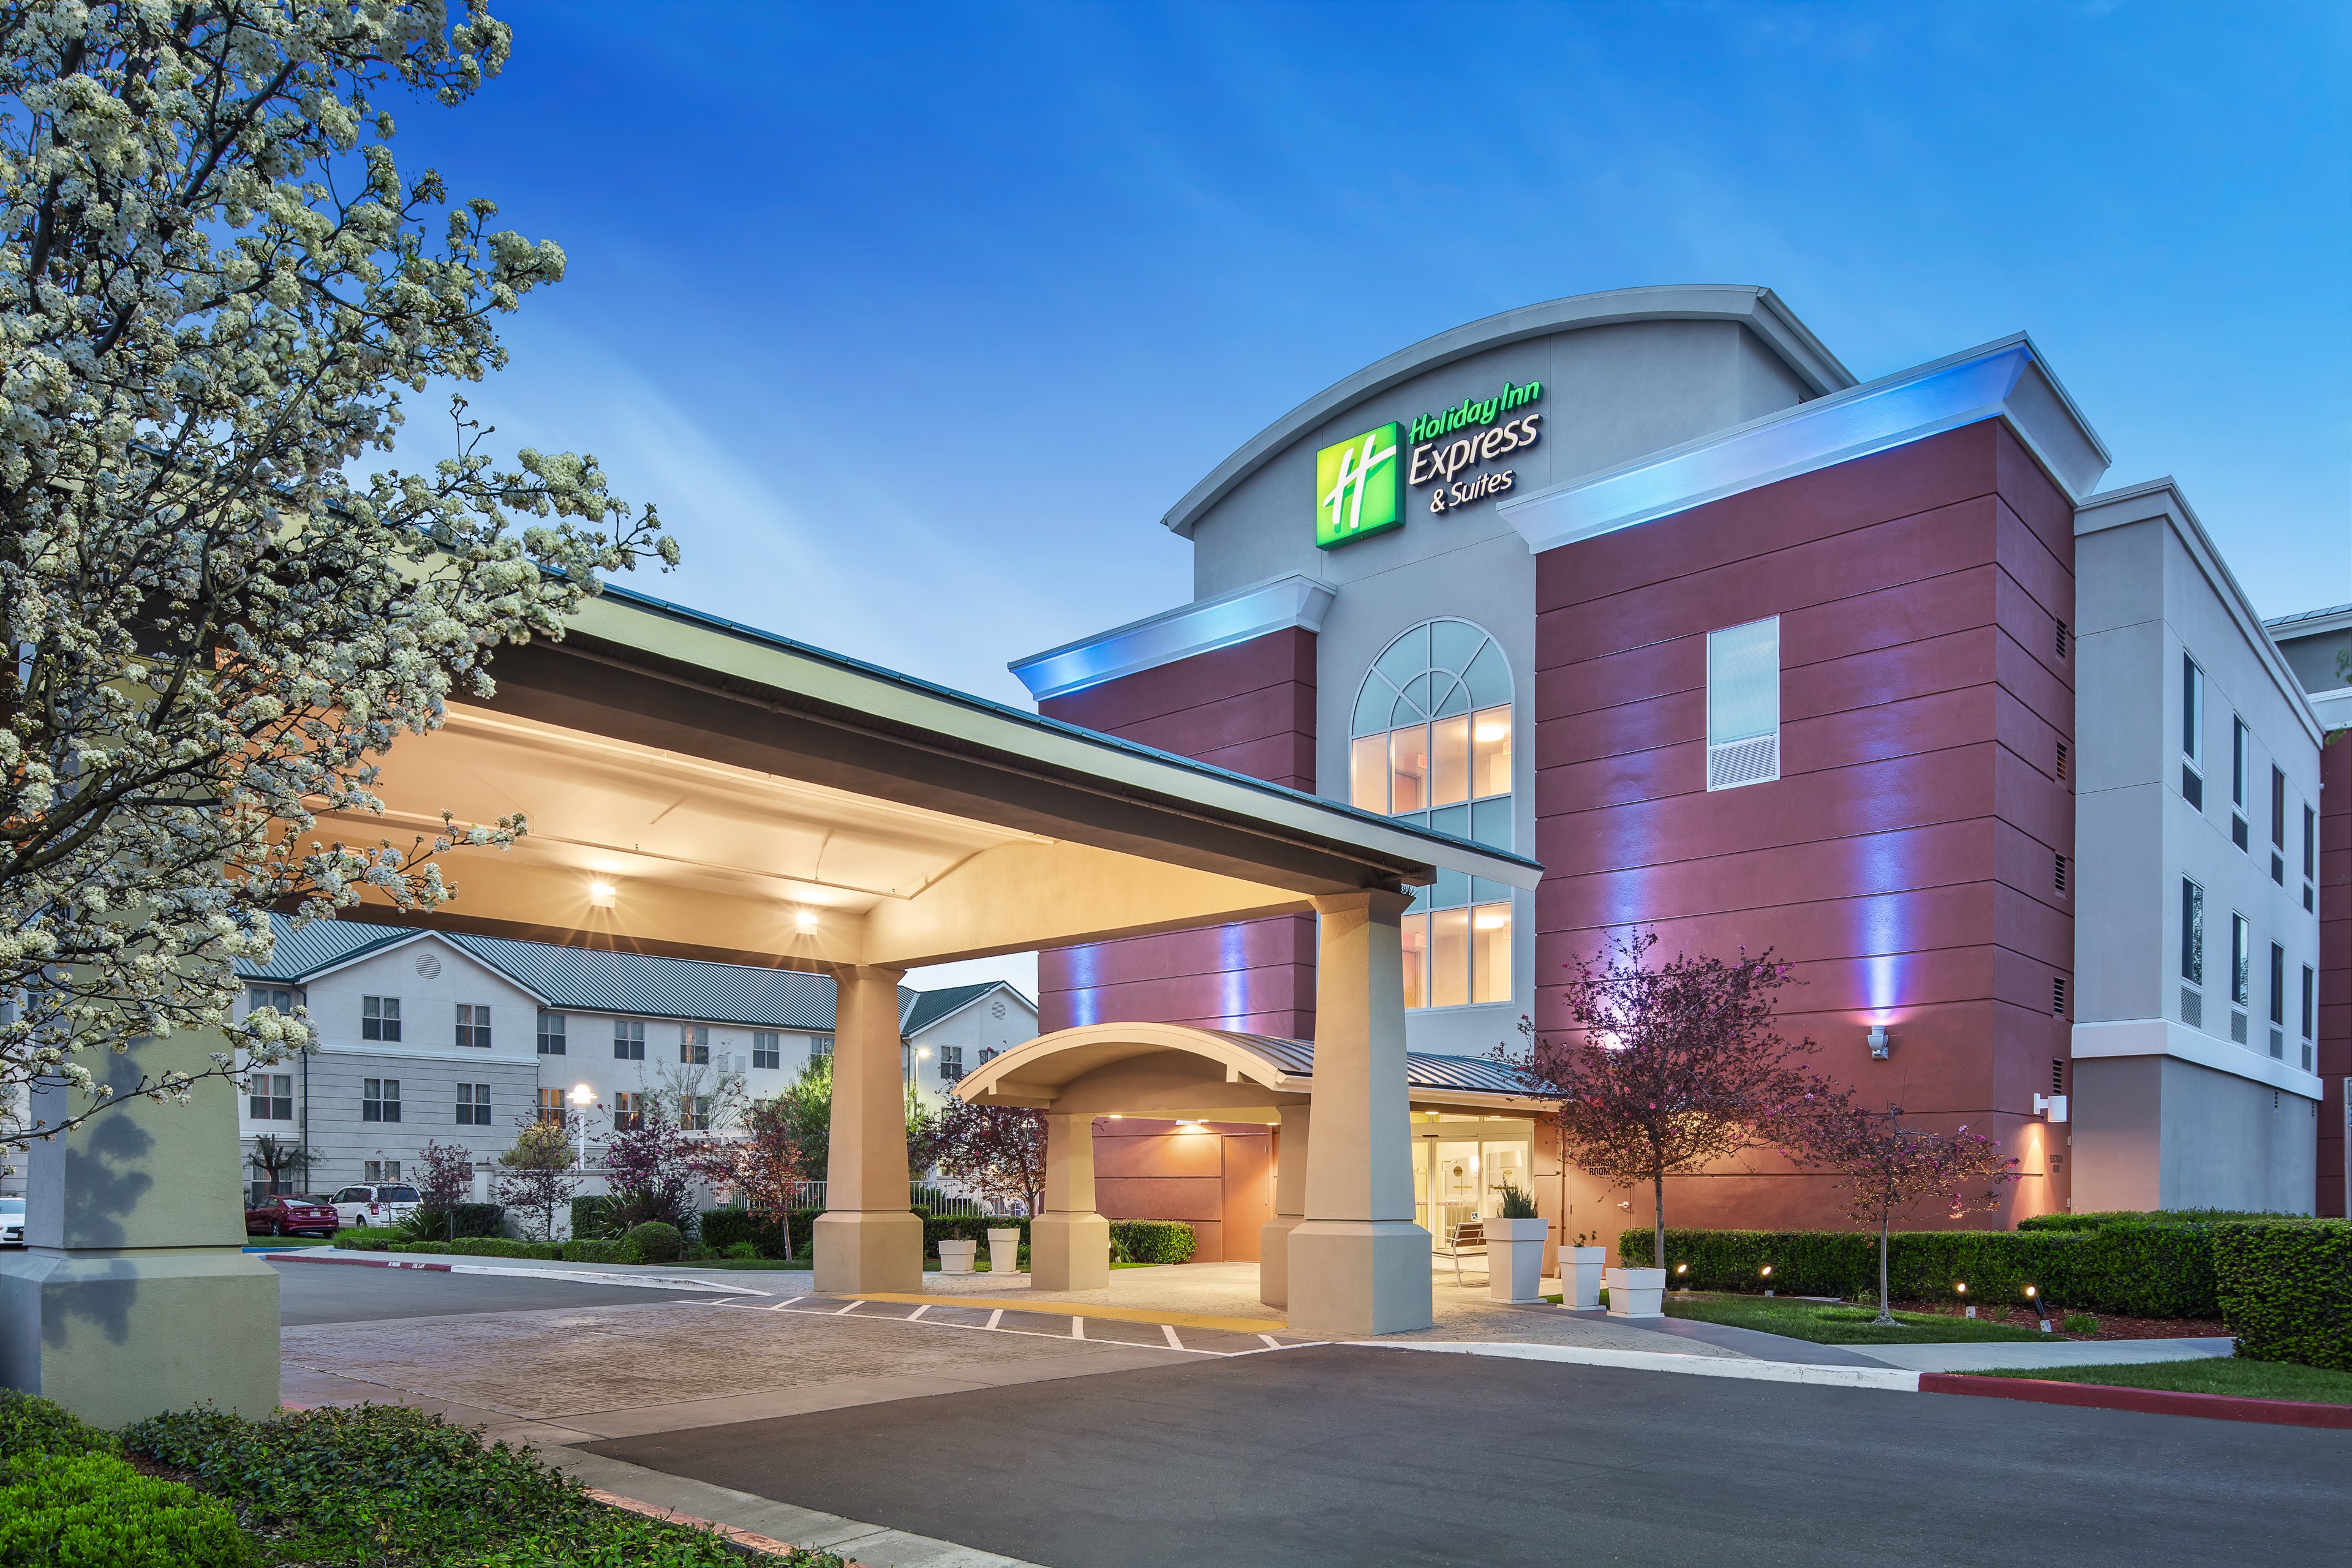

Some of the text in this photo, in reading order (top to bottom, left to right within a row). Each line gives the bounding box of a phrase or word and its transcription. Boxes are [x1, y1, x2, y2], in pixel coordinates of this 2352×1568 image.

[1408, 380, 1540, 446] Holiday Inn
[1409, 413, 1540, 486] Express
[1430, 469, 1514, 513] & Suites
